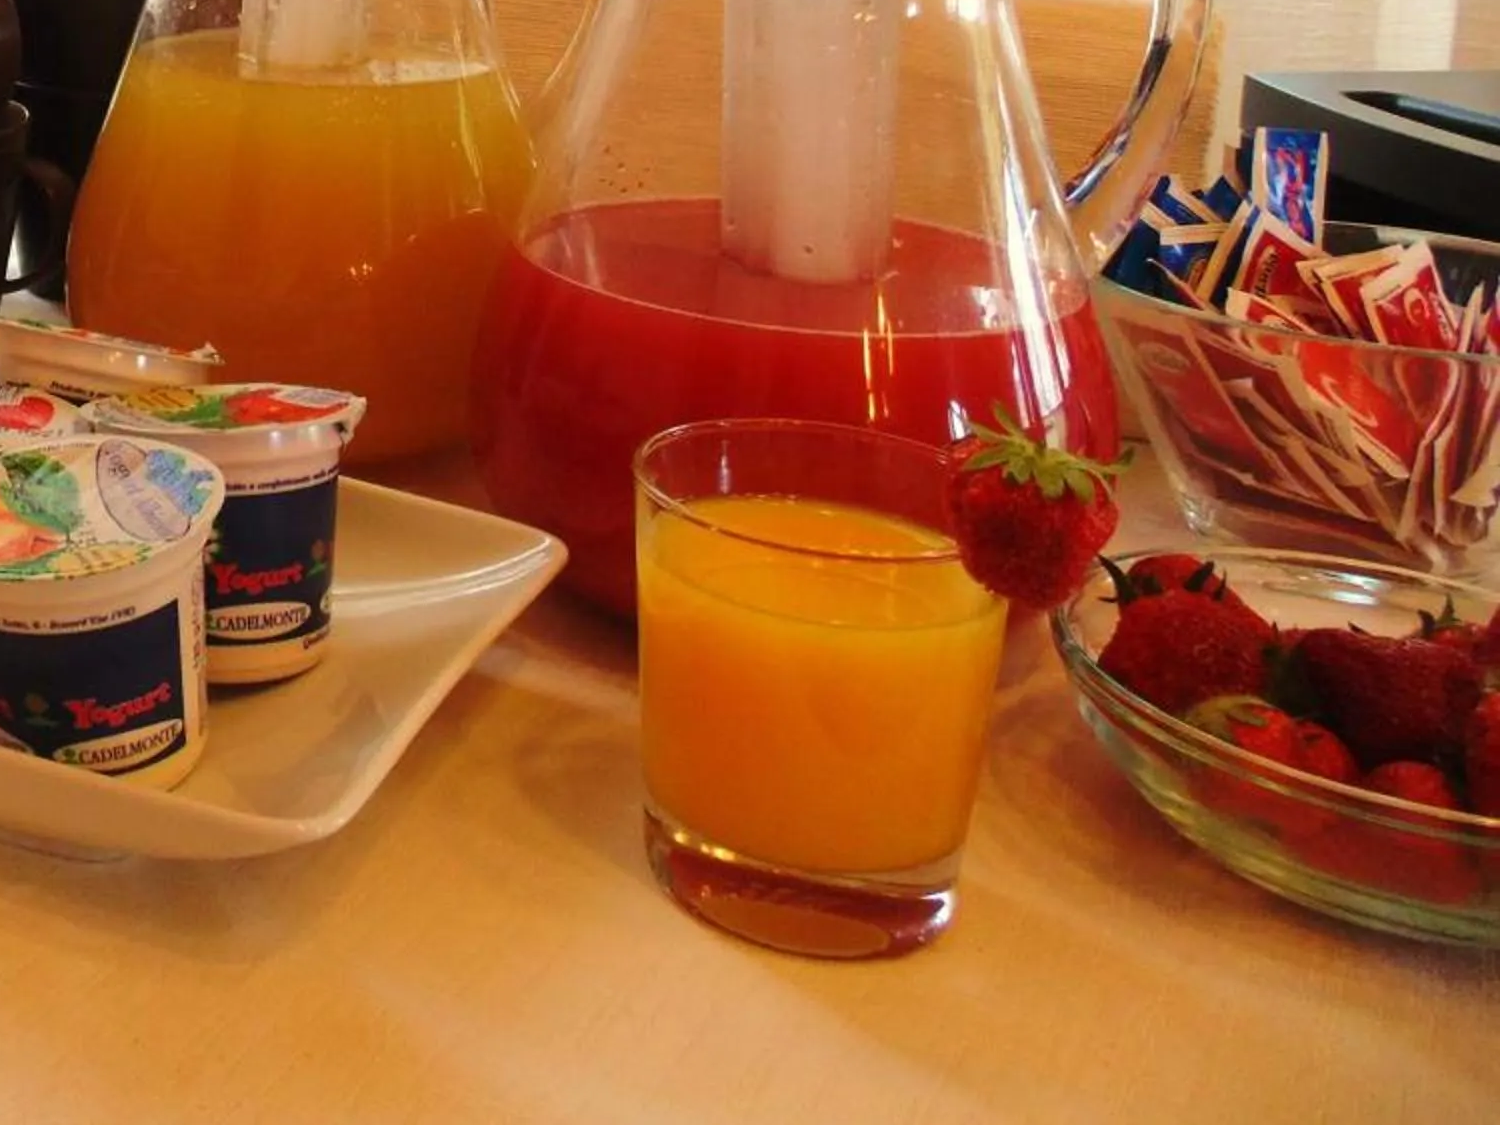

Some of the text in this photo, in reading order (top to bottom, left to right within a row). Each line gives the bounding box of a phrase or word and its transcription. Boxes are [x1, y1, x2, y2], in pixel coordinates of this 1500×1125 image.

[211, 562, 304, 596] Yogurt
[63, 681, 173, 730] Yogurt
[78, 724, 180, 766] CADELMONTE
